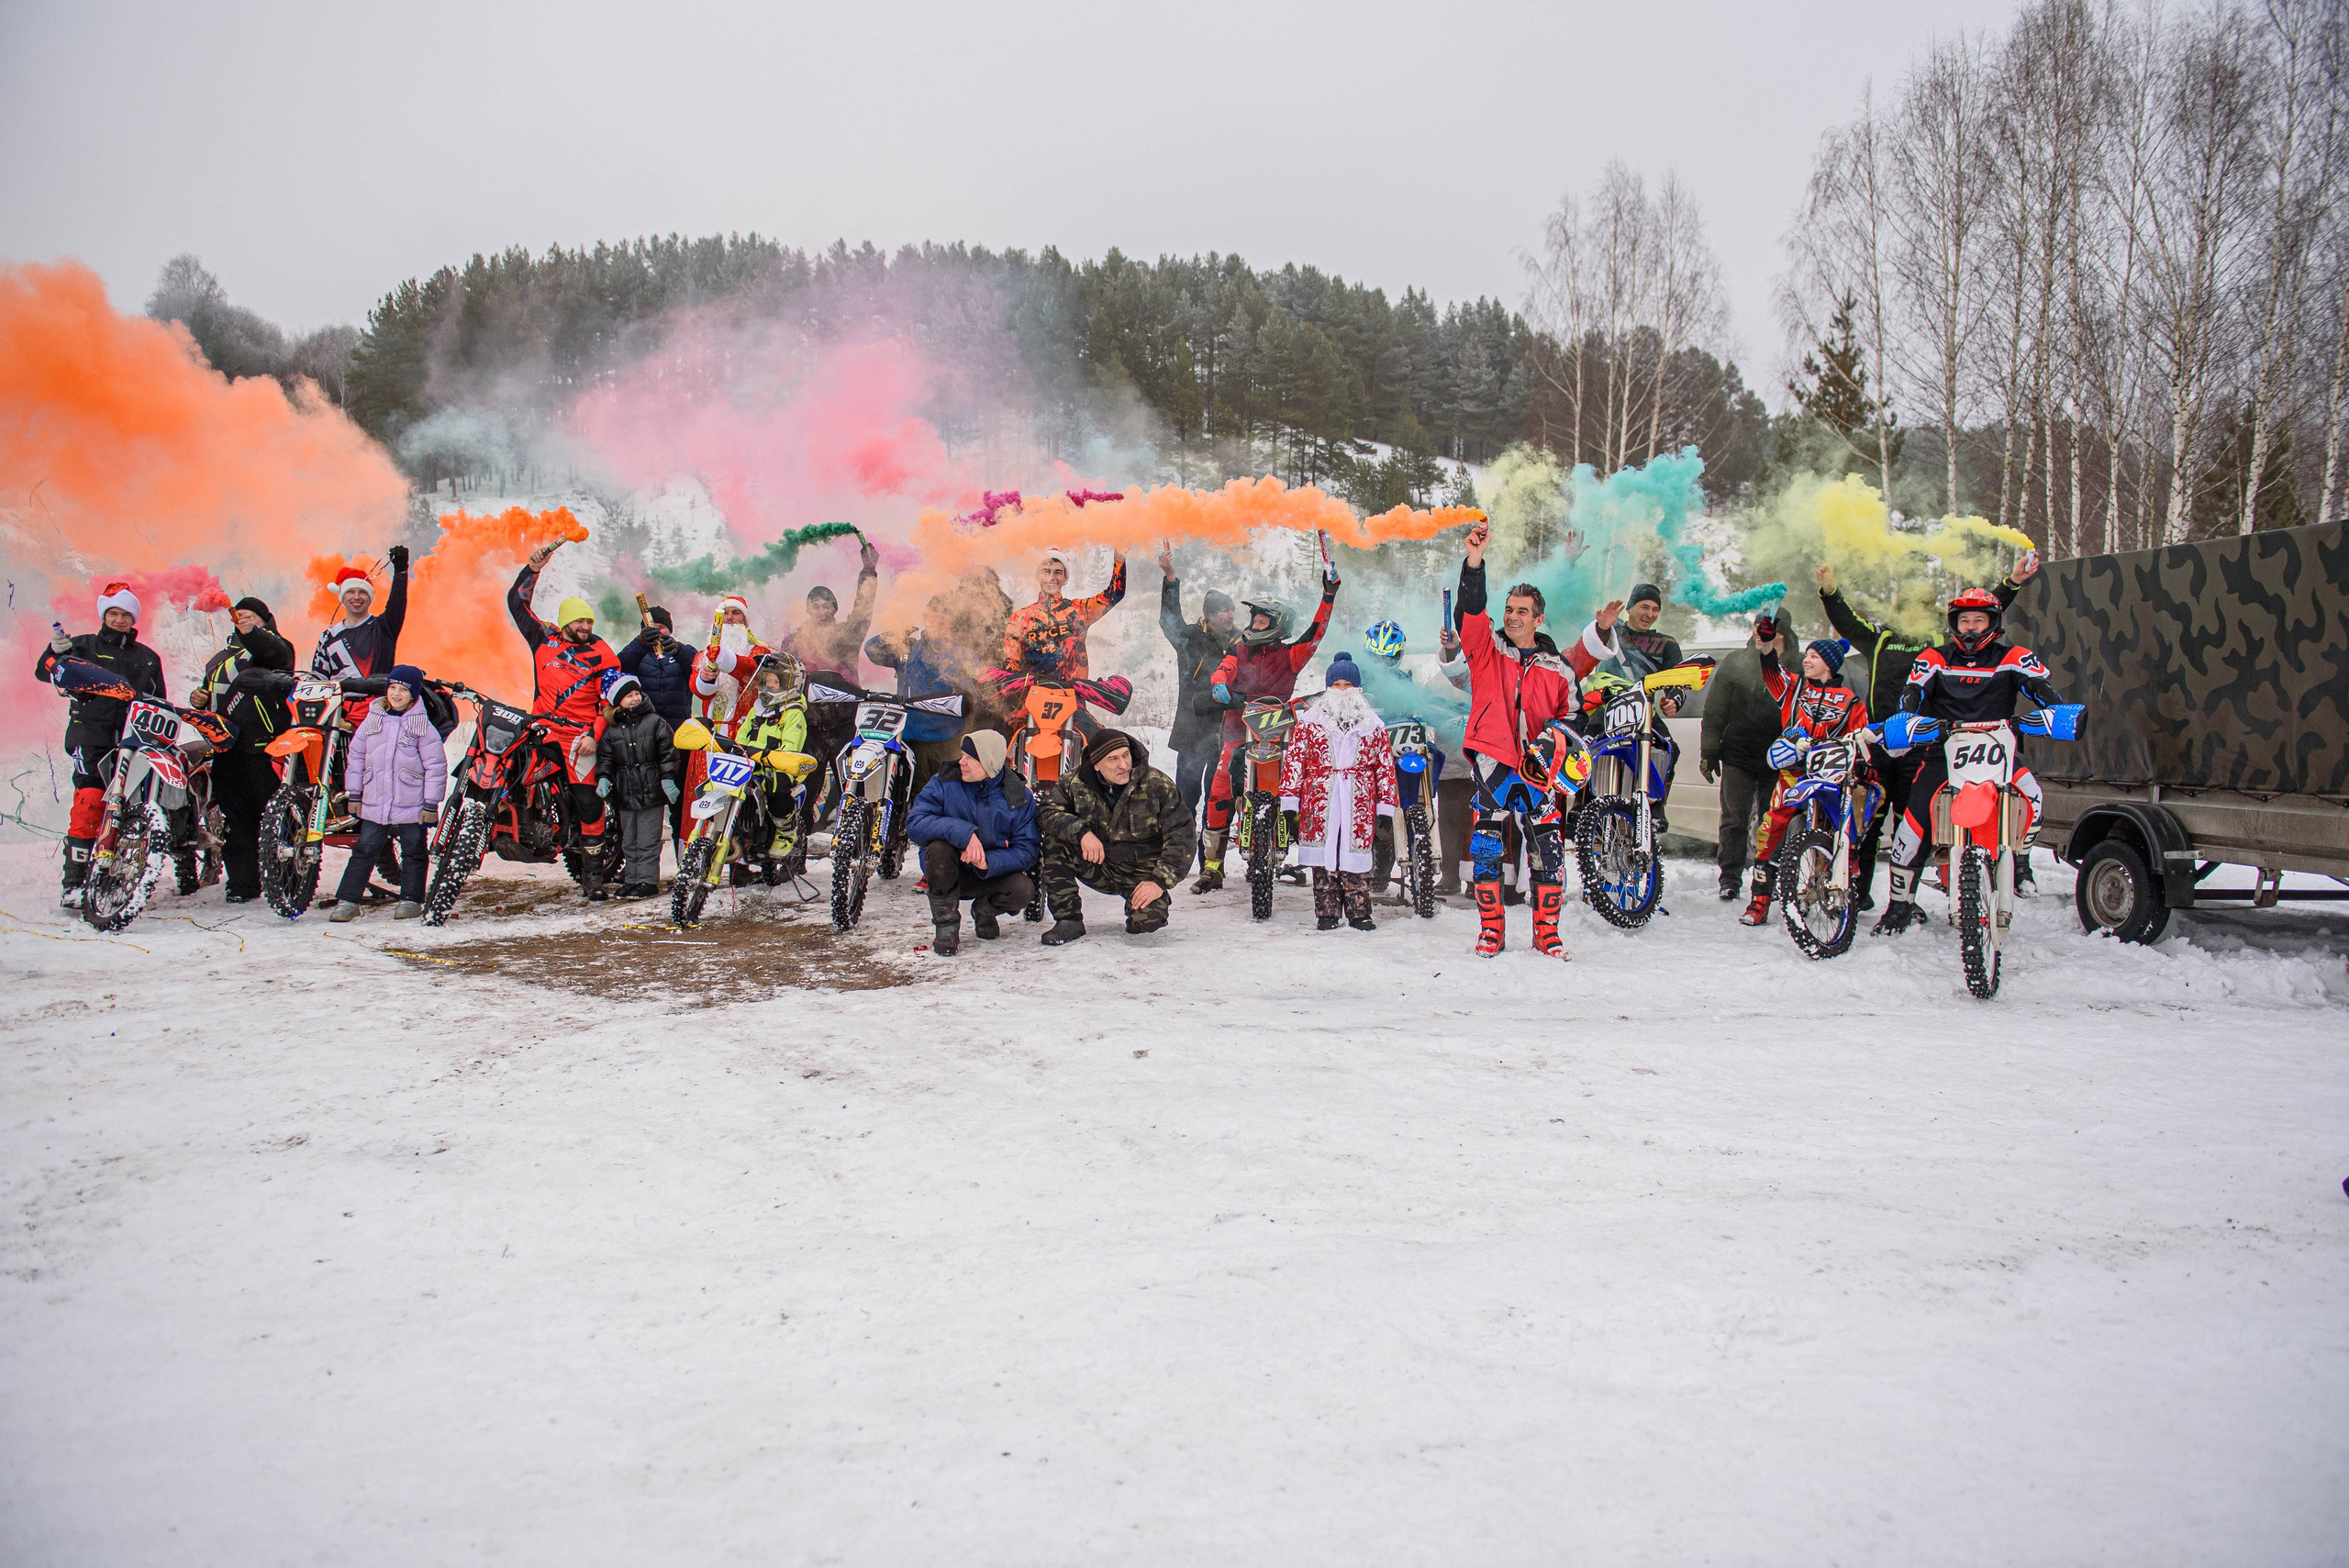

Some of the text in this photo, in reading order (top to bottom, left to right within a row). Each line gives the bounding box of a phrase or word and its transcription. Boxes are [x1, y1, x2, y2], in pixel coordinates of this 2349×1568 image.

[859, 709, 905, 732] 32
[1041, 702, 1063, 719] 37
[1259, 710, 1283, 728] 11
[1606, 701, 1642, 731] 700
[134, 710, 178, 740] 400
[1809, 748, 1847, 773] 82
[1954, 743, 2006, 770] 540
[711, 760, 751, 782] 717
